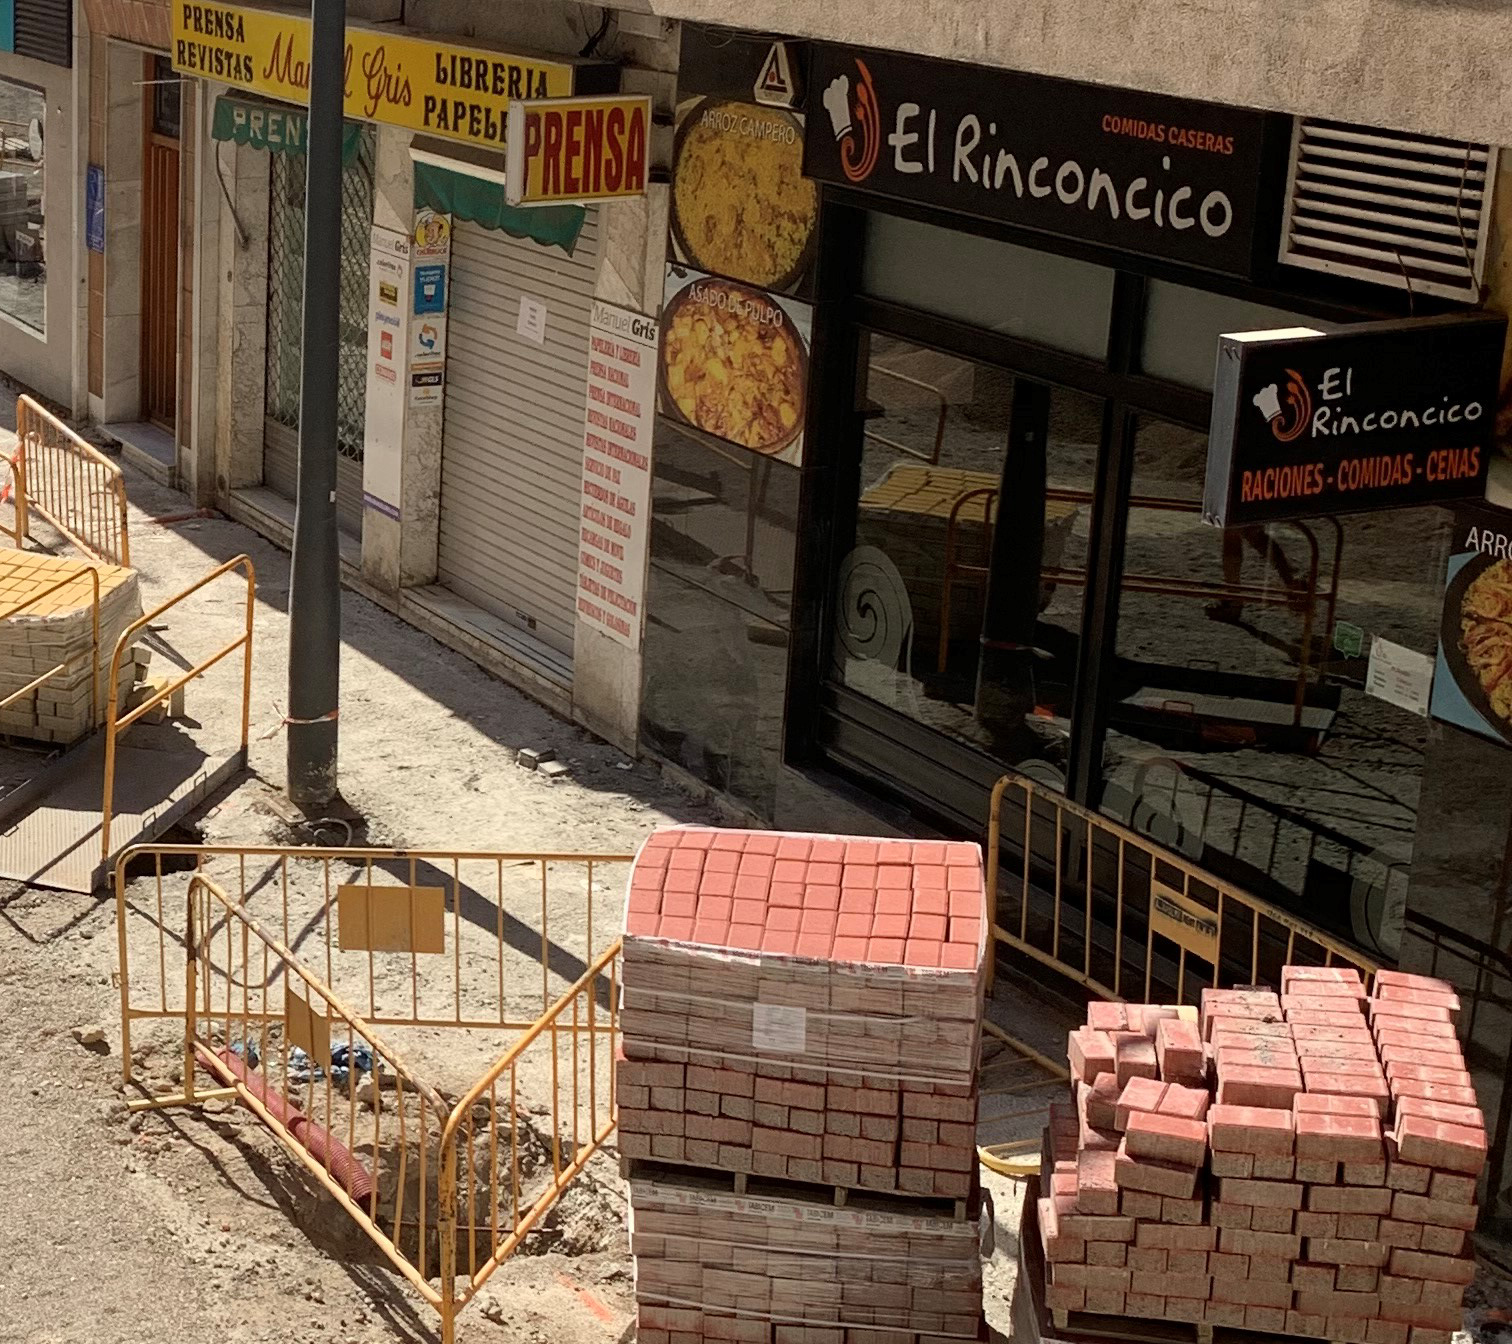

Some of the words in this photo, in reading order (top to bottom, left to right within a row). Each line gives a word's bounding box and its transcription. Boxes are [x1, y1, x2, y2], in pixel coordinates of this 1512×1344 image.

[182, 3, 245, 43] PRENSA
[176, 39, 254, 83] REVISTAS
[263, 32, 353, 98] Mal
[362, 45, 412, 117] Gris
[435, 52, 548, 99] LIBRERIA
[233, 107, 302, 146] PREN
[424, 95, 508, 144] PAPEL
[701, 110, 738, 133] ARROZ
[739, 117, 795, 144] CAMPERO
[1101, 114, 1165, 142] COMIDAS
[1168, 126, 1234, 154] CASERAS
[523, 107, 645, 196] PRENSA
[888, 102, 936, 173] El
[953, 113, 1233, 237] Rinconcico
[593, 309, 630, 333] Manuel
[632, 319, 656, 341] Gris
[689, 284, 726, 309] ASADO
[728, 295, 743, 314] DE
[743, 300, 783, 327] PULPO
[1318, 367, 1352, 400] El
[1312, 396, 1483, 438] Rinconcico
[1241, 463, 1324, 502] RACIONES
[1337, 453, 1413, 491] COMIDAS
[1426, 446, 1480, 482] CENAS
[748, 1201, 775, 1212] TABICEM
